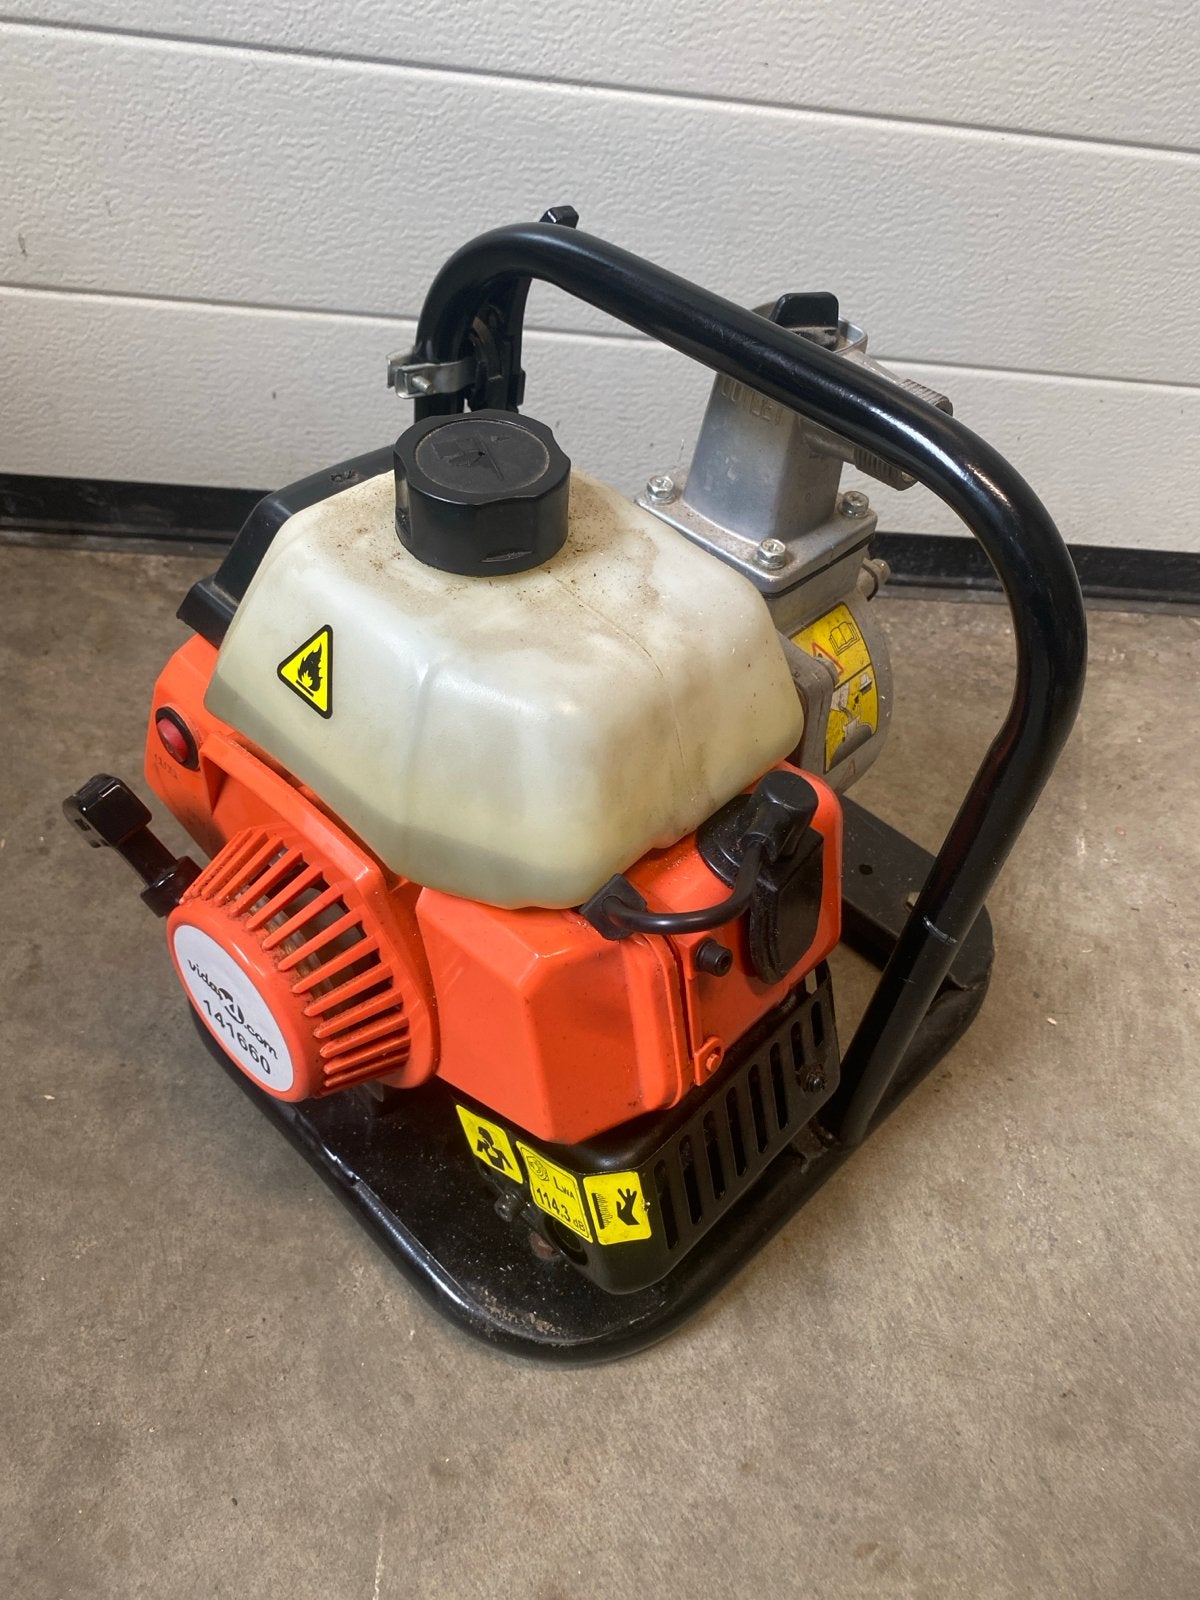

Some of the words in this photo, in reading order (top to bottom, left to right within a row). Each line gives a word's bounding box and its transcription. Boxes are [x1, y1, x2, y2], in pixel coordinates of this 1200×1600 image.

[203, 999, 271, 1075] 141660
[536, 1187, 571, 1223] 114.3
[573, 1218, 586, 1232] dB
